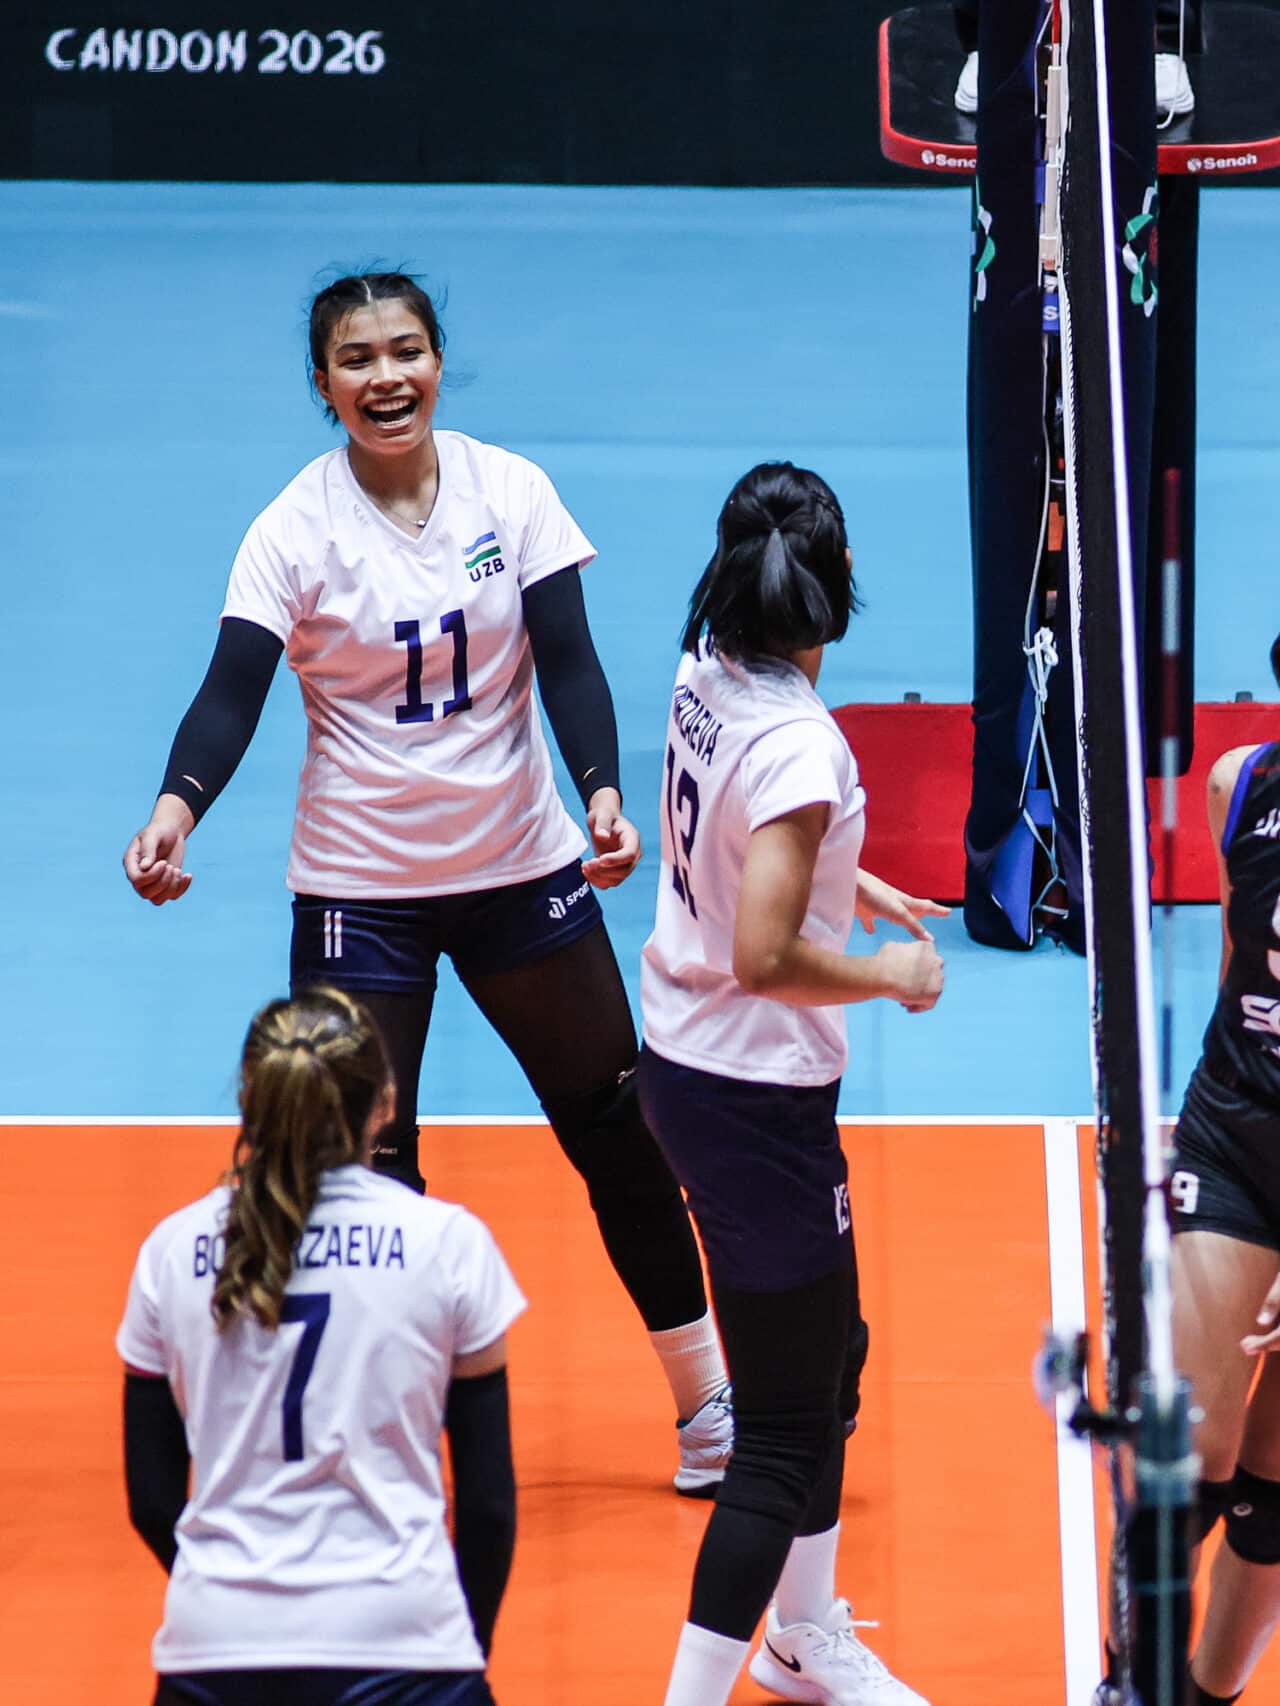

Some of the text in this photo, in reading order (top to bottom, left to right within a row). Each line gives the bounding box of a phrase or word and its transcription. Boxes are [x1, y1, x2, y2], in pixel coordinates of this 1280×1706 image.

[45, 28, 387, 74] CANDON 2026
[1203, 153, 1257, 170] Senoh
[470, 557, 505, 583] UZB
[394, 608, 473, 725] 11
[324, 910, 343, 958] 11
[1171, 1171, 1200, 1214] 9
[194, 1225, 405, 1279] BOZAEVA
[276, 1292, 331, 1462] 7
